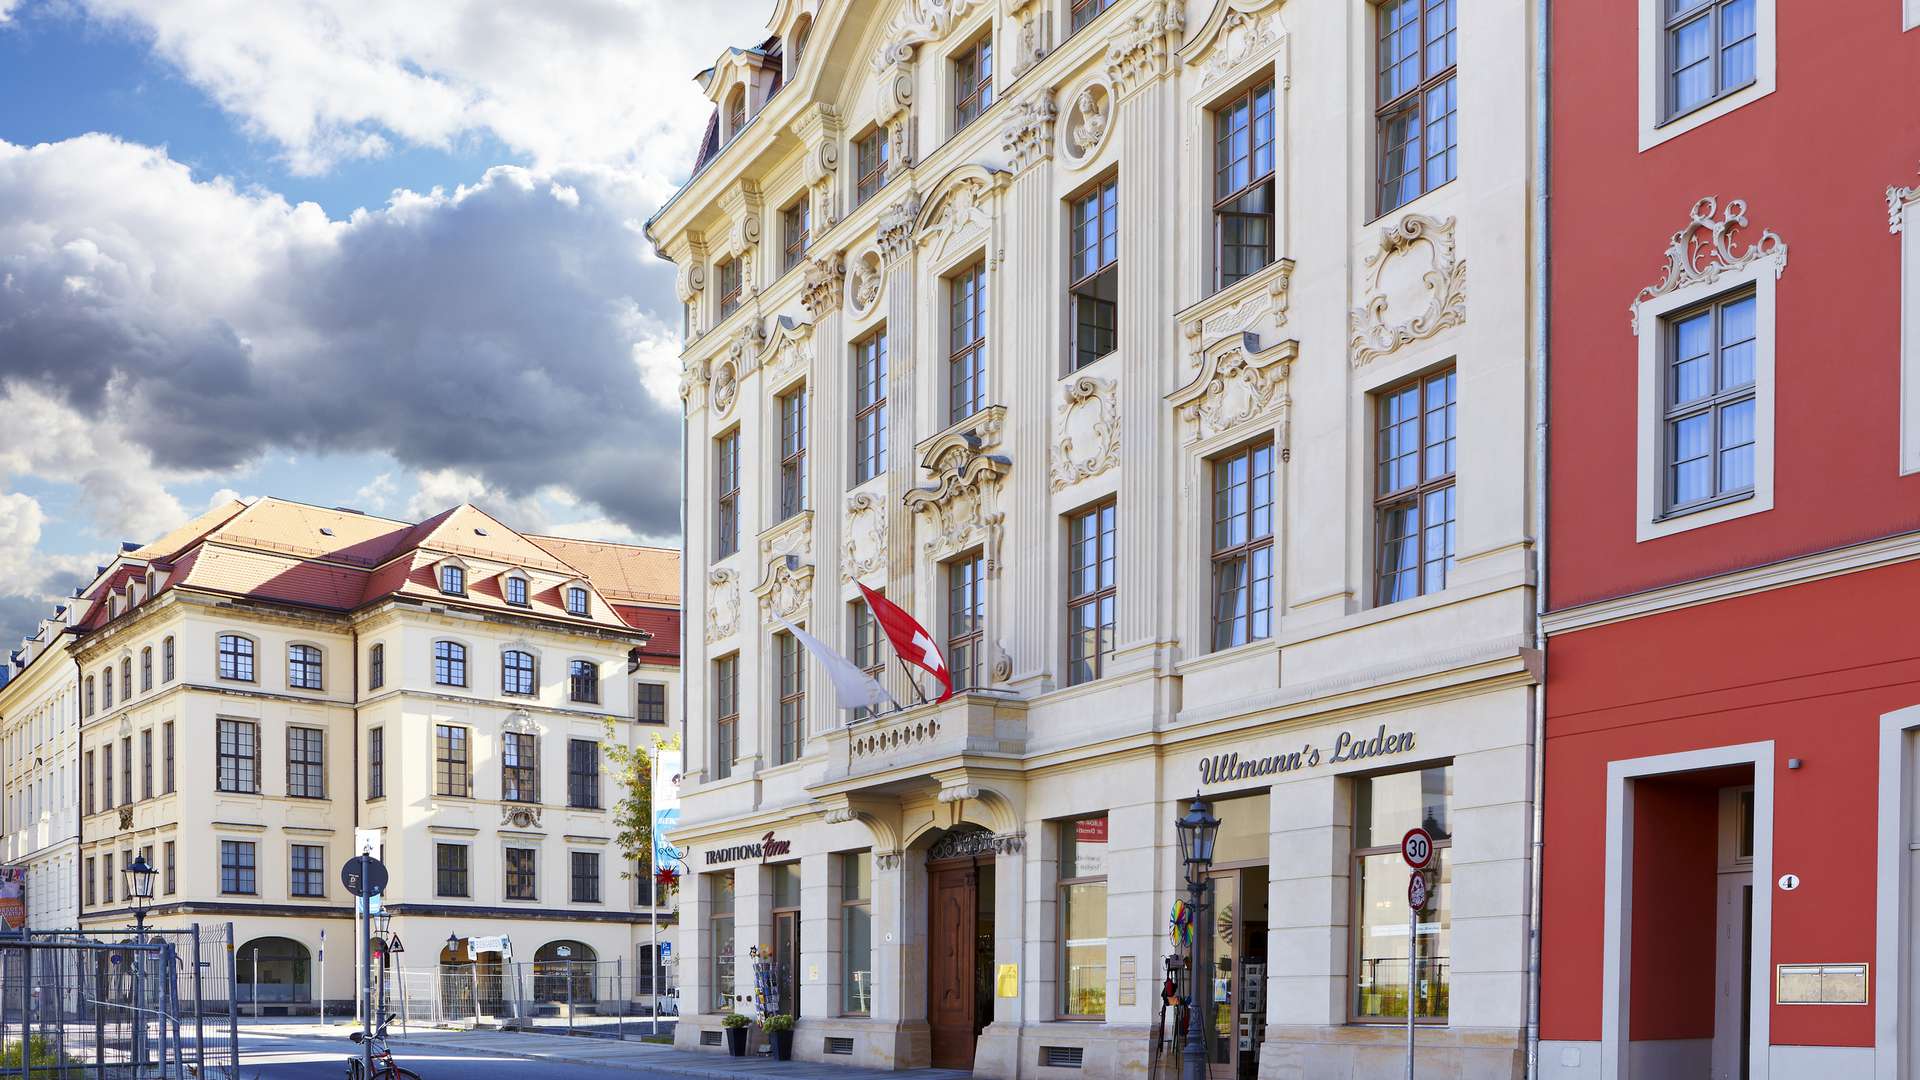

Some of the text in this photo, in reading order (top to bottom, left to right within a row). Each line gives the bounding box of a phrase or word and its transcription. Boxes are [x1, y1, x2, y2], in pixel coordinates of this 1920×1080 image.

[1199, 723, 1416, 785] Ullmann's Laden
[1408, 839, 1427, 858] 30
